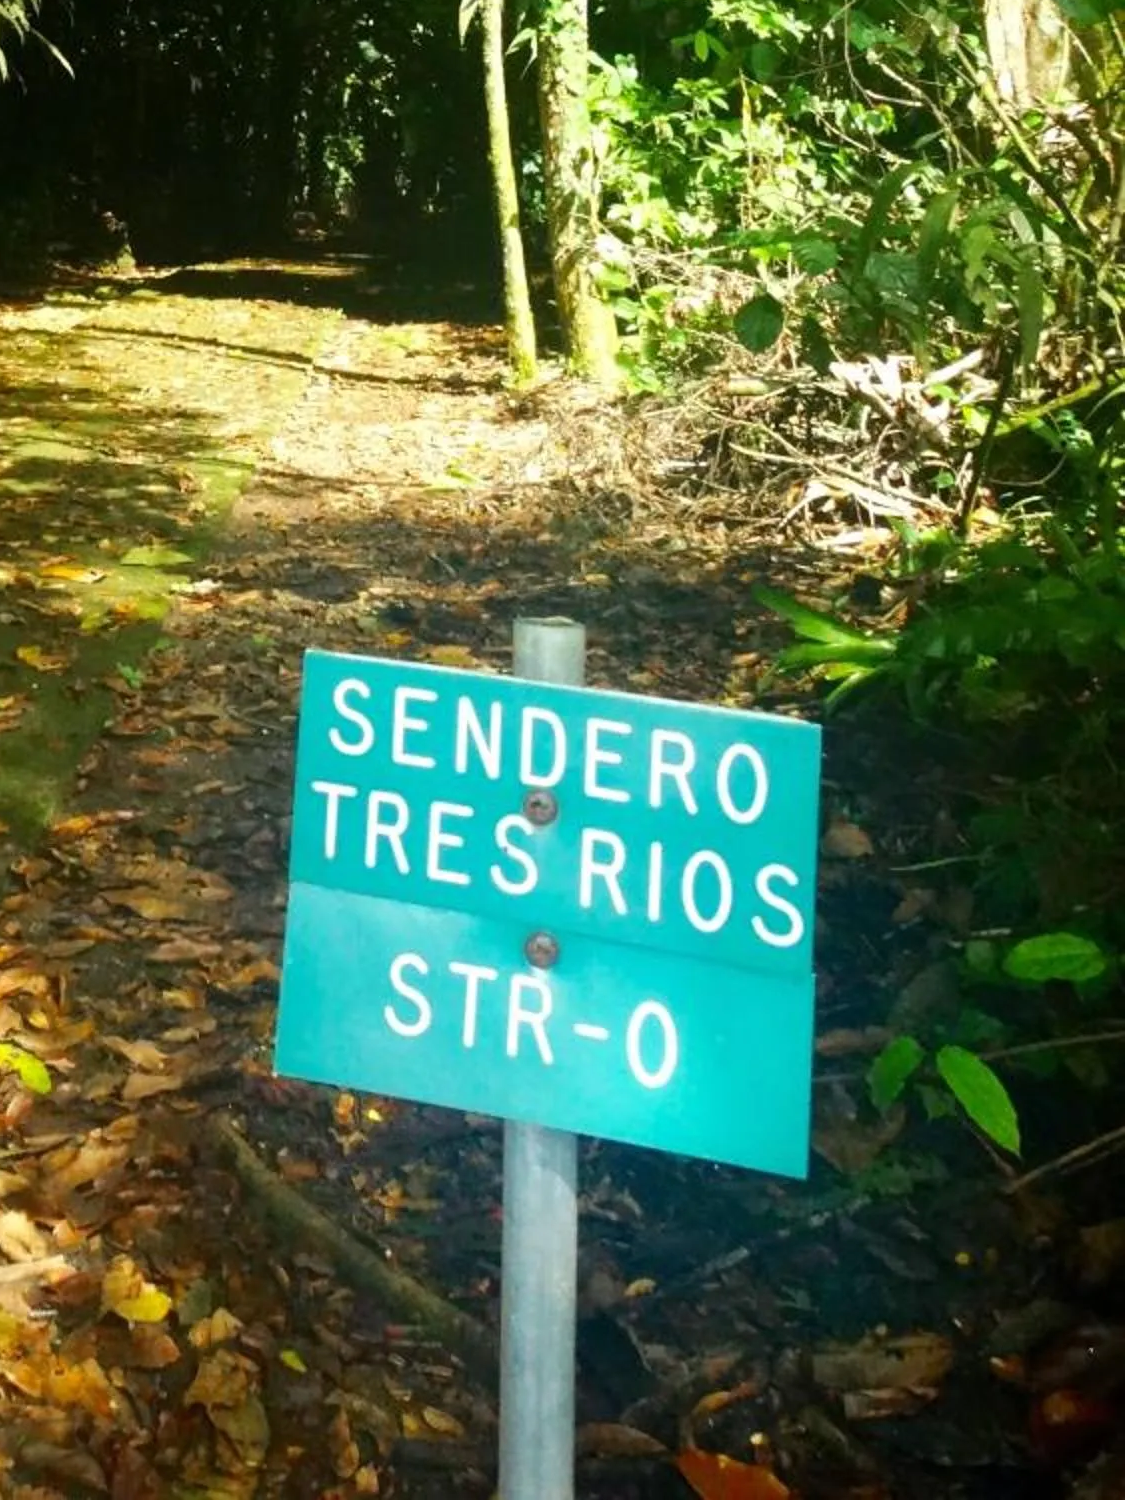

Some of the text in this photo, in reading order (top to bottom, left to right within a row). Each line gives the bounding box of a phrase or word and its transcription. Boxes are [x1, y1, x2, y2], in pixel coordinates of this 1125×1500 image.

[329, 679, 769, 824] SENDERO
[311, 781, 804, 947] TRES RIOS
